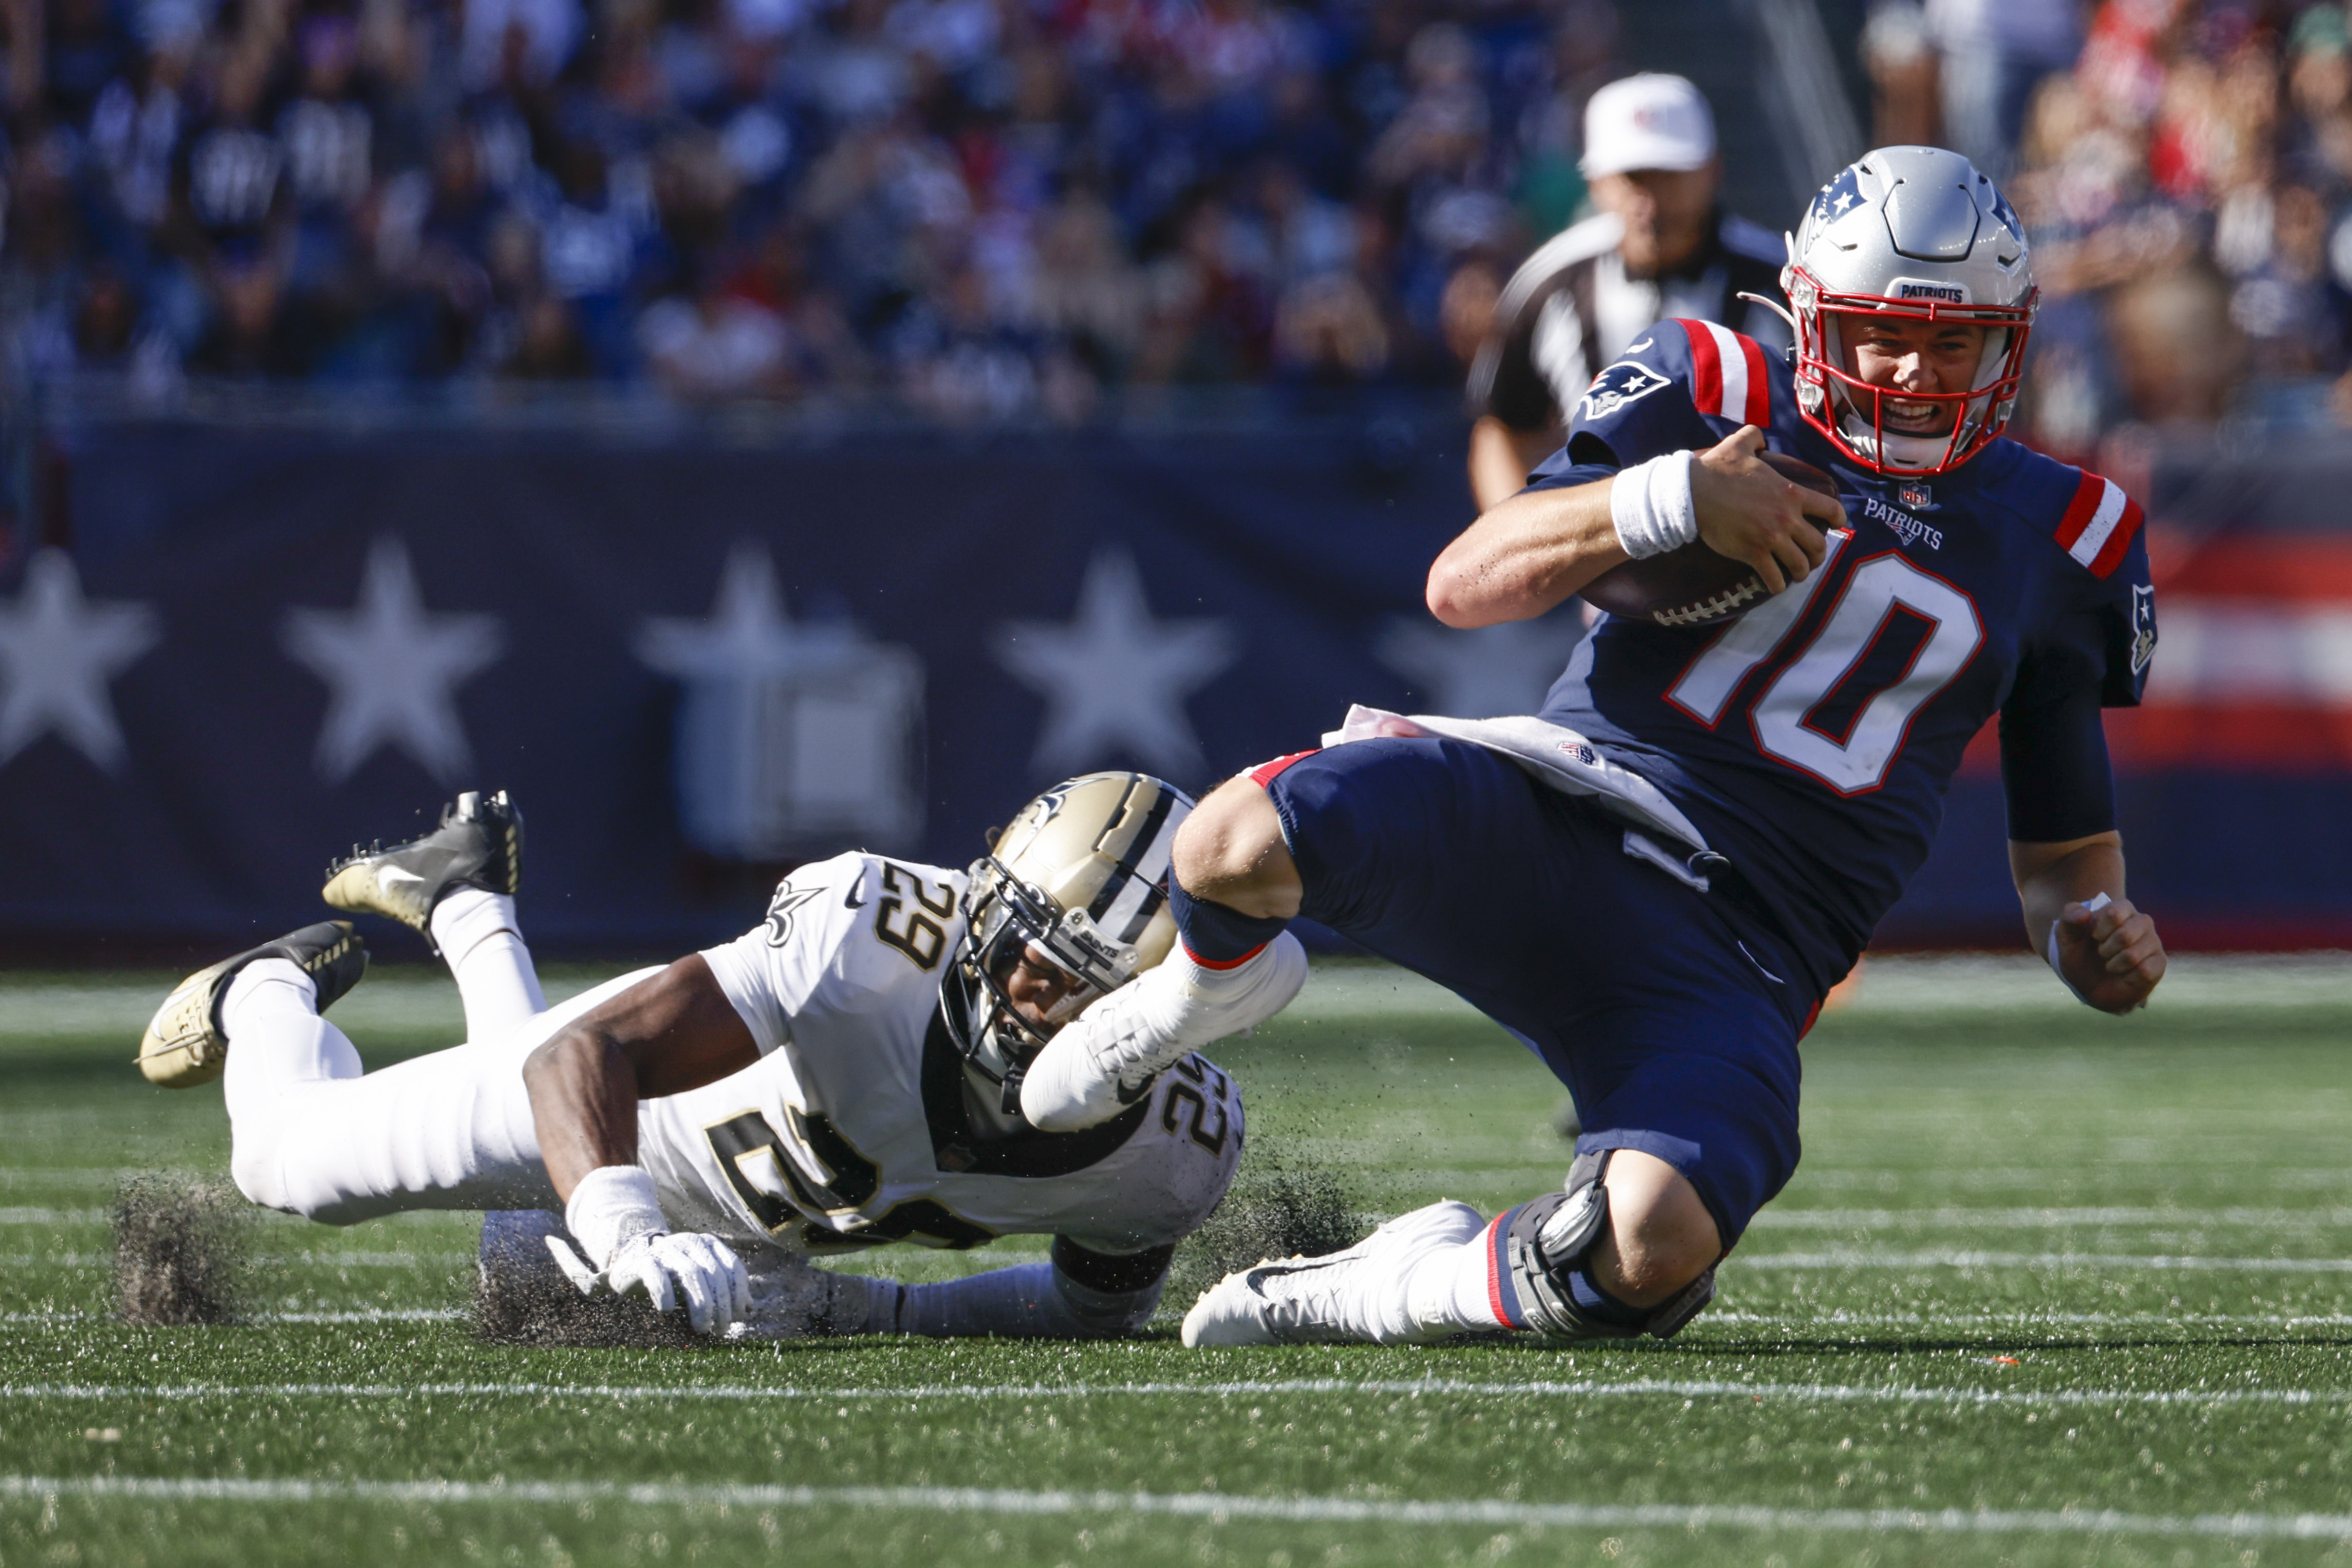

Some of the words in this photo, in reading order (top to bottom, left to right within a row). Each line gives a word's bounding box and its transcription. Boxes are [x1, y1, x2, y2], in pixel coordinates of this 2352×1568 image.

[1901, 284, 1963, 304] PATRIOTS
[1864, 497, 1943, 550] PATRIOTS
[1661, 527, 1987, 798] 10
[874, 858, 957, 973] 29
[1080, 930, 1120, 958] SAINTS
